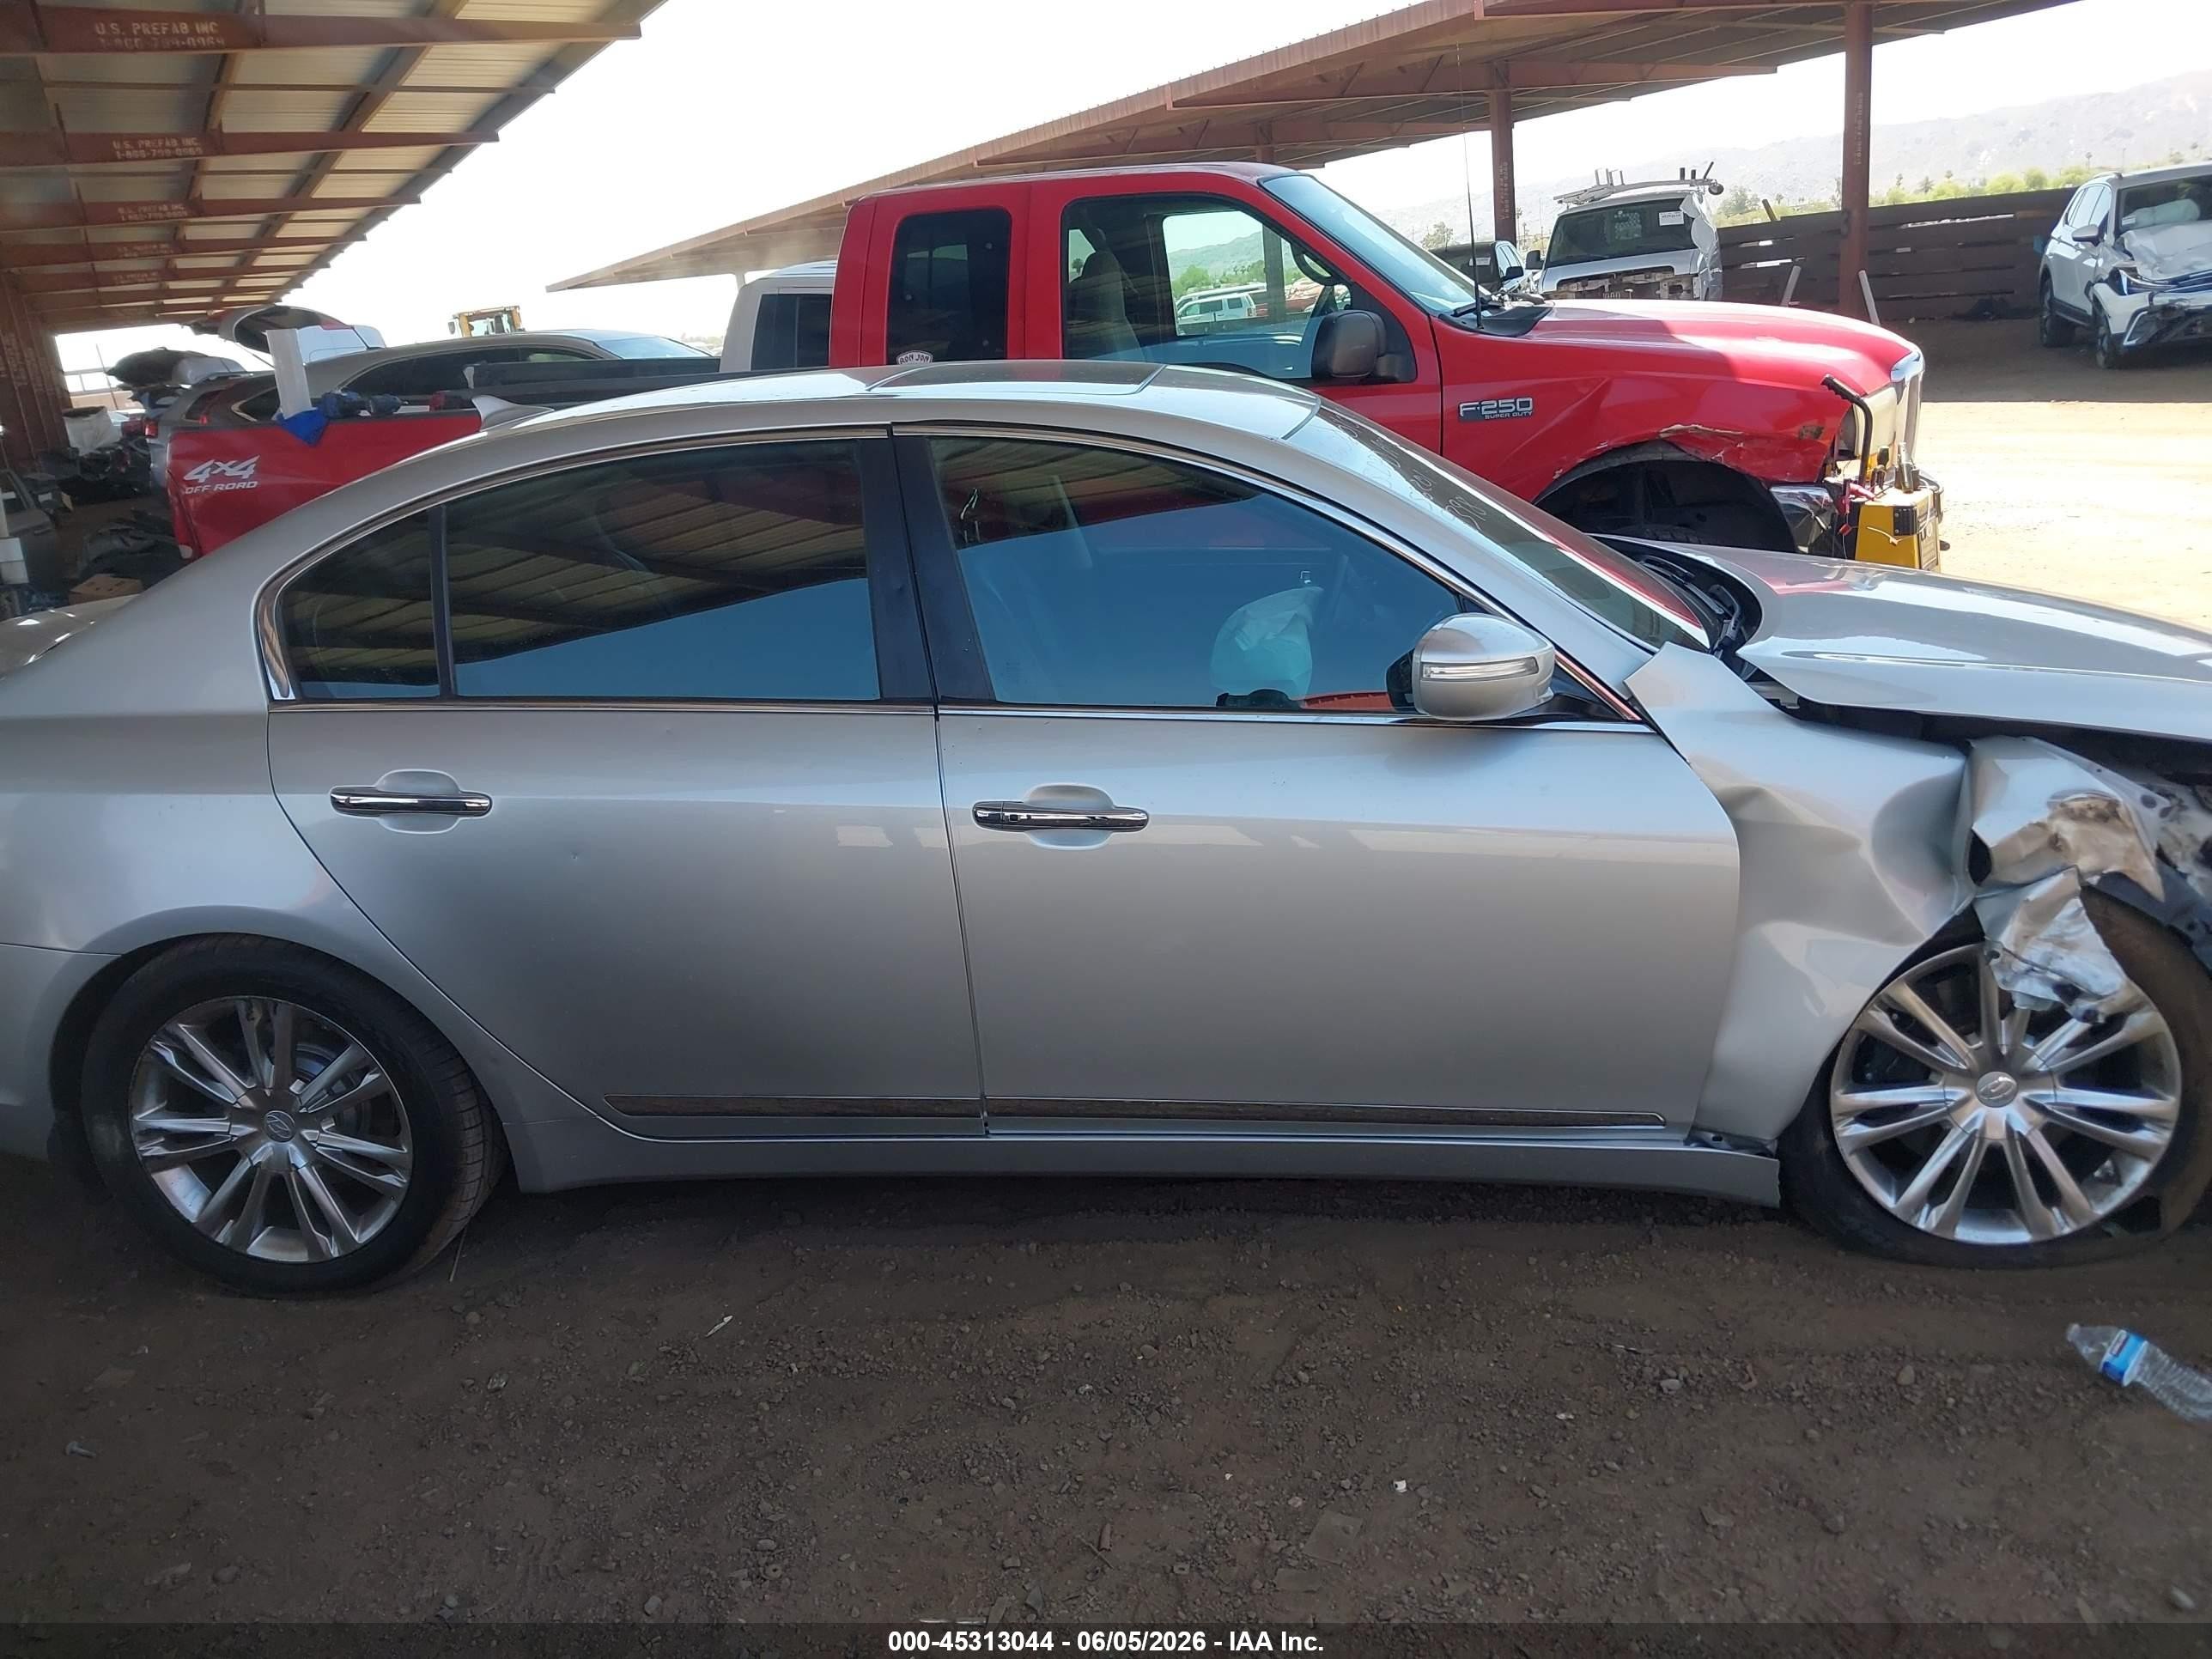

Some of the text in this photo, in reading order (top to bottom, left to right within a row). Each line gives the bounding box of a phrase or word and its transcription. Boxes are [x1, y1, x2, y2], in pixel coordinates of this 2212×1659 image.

[131, 21, 190, 35] PREFAB
[185, 481, 258, 495] OFF ROAD
